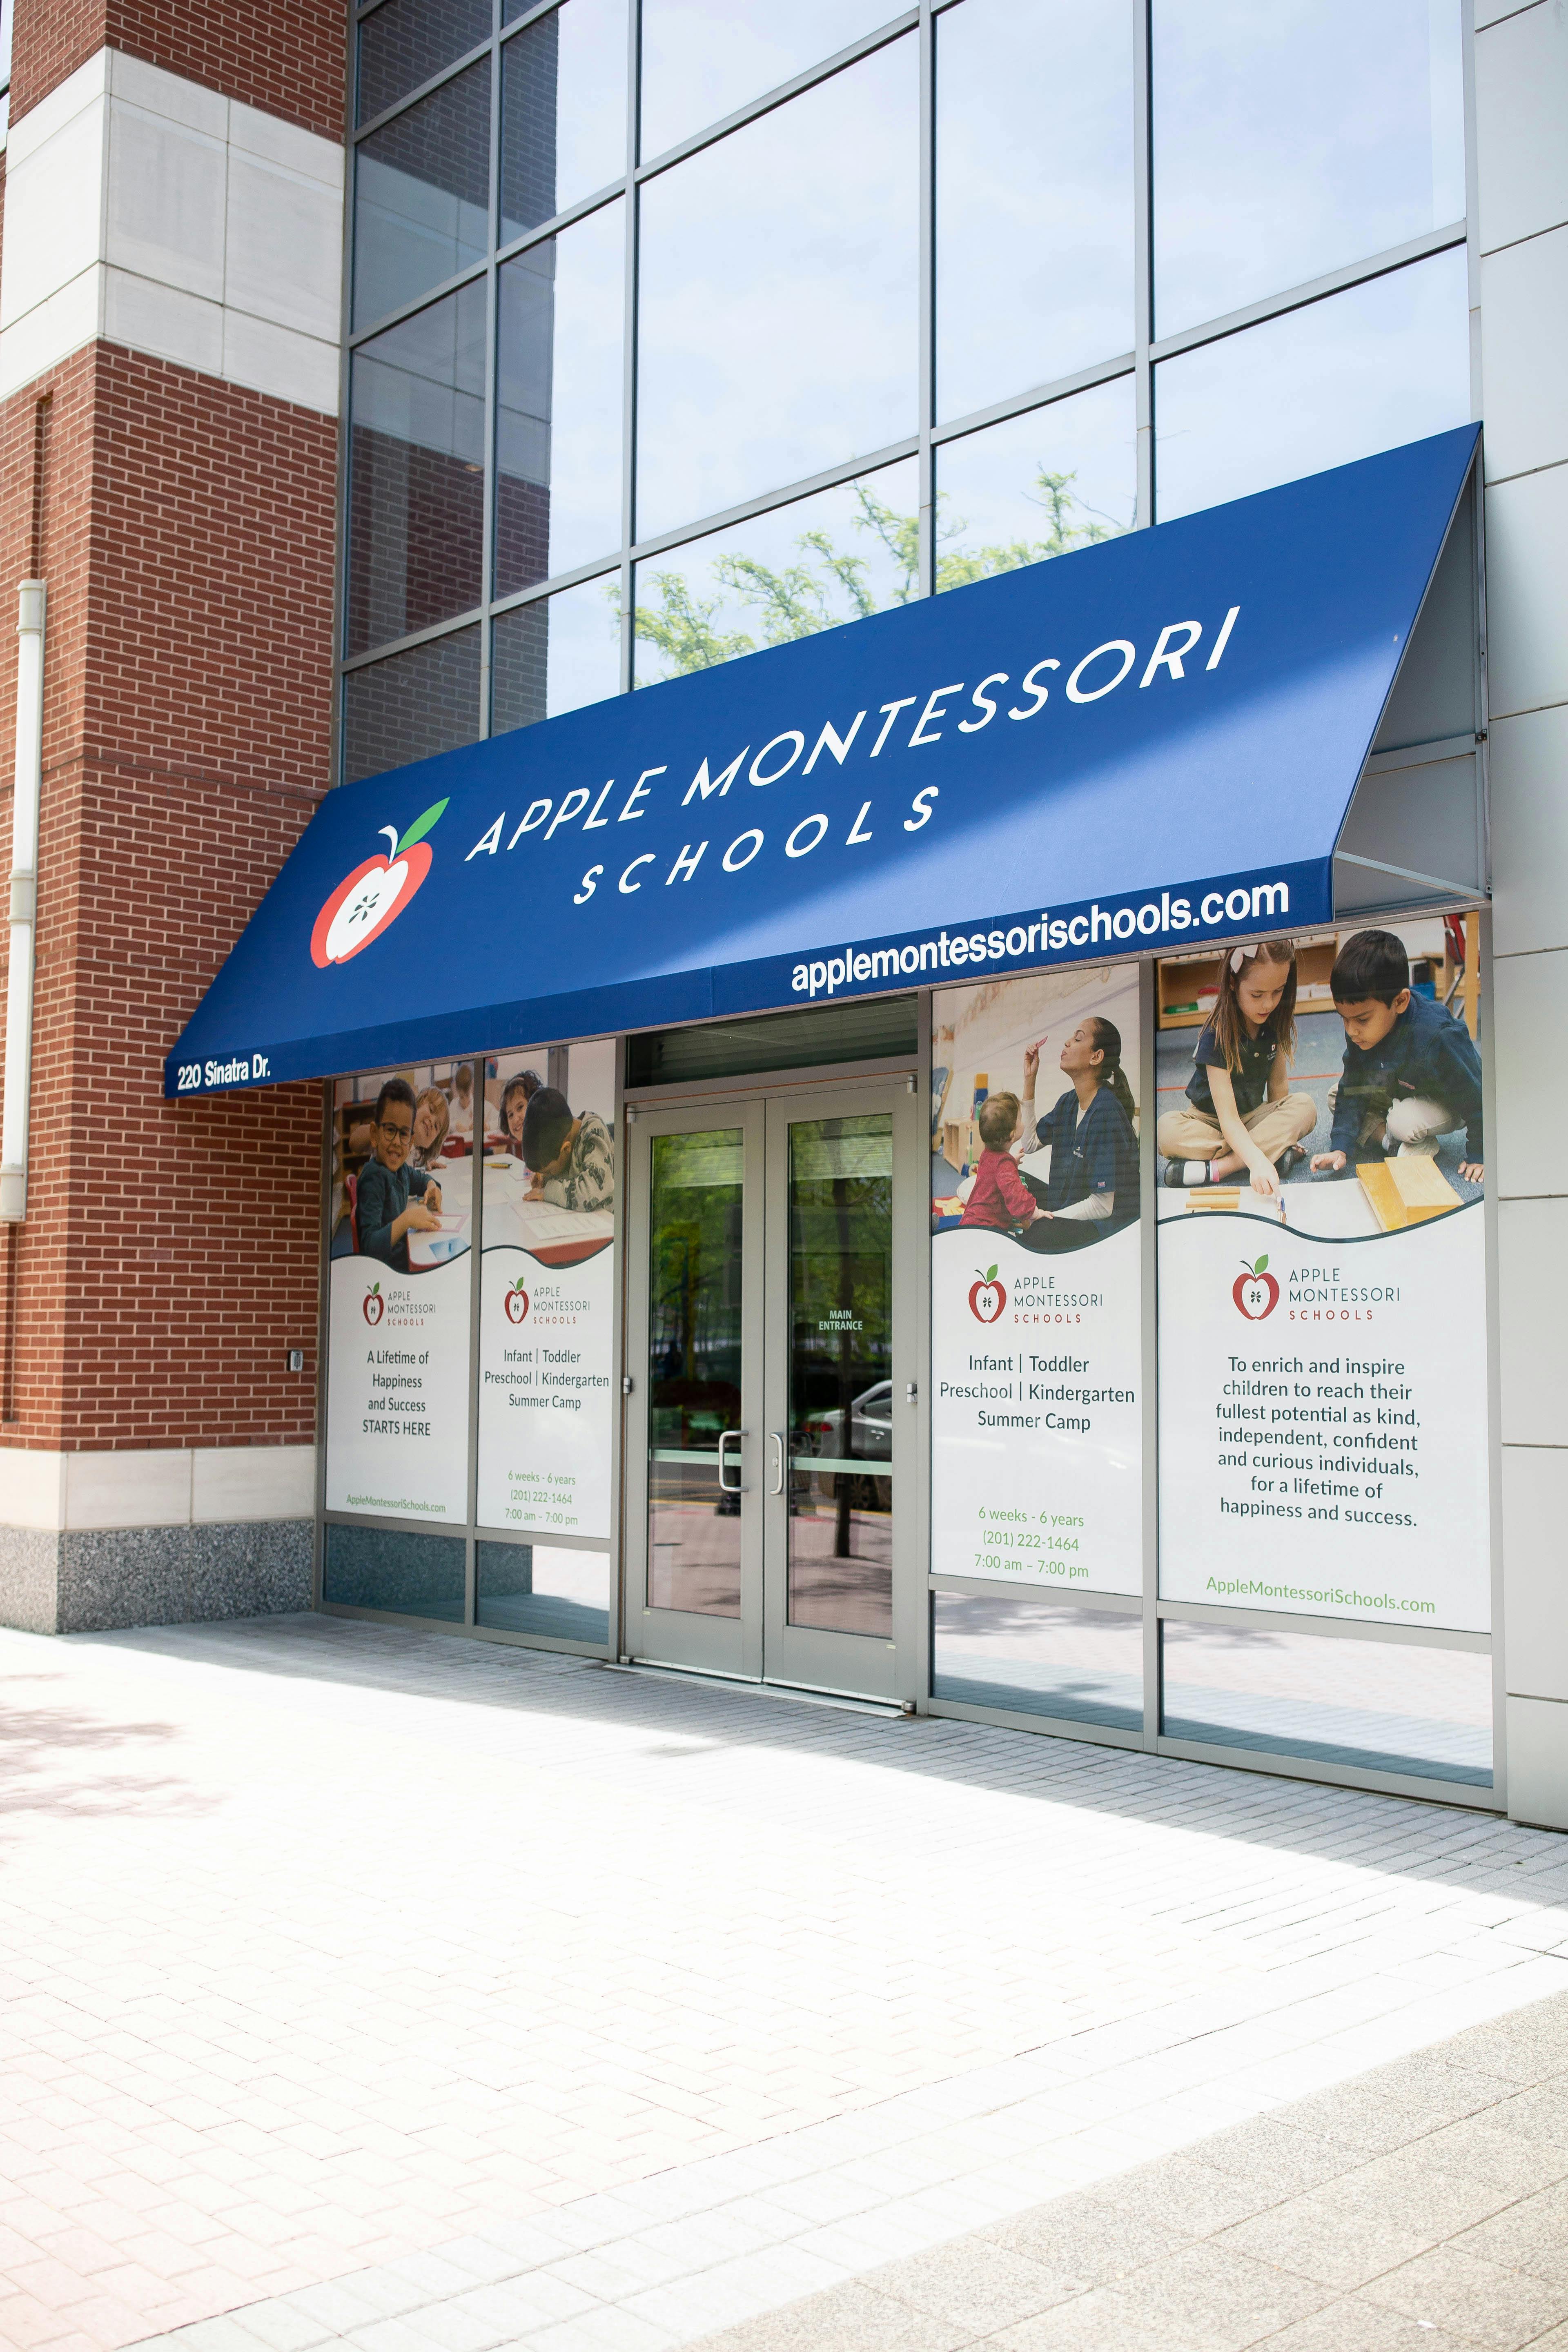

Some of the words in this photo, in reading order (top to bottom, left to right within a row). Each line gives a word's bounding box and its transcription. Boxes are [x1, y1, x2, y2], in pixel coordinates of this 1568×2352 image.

[465, 765, 667, 861] APPLE
[681, 606, 1241, 806] MONTESSORI
[573, 786, 939, 905] SCHOOLS
[792, 882, 1289, 997] applemontessorischools.com
[178, 1064, 201, 1090] 220
[205, 1058, 249, 1087] Sinatra
[253, 1054, 270, 1079] Dr.
[1014, 1276, 1055, 1289] APPLE
[1289, 1268, 1340, 1282] APPLE
[388, 1291, 410, 1301] APPLE
[534, 1287, 560, 1297] APPLE
[1014, 1294, 1102, 1307] MONTESSORI
[1290, 1287, 1399, 1302] MONTESSORI
[388, 1304, 436, 1314] MONTESSORI
[534, 1301, 590, 1311] MONTESSORI
[829, 1310, 852, 1319] MAIN
[388, 1318, 424, 1326] SCHOOLS
[533, 1316, 576, 1324] SCHOOLS
[1014, 1314, 1080, 1323] SCHOOLS
[1290, 1310, 1372, 1320] SCHOOLS
[819, 1321, 863, 1330] ENTRANCE
[367, 1350, 374, 1363] A
[377, 1350, 416, 1364] Lifetime
[419, 1351, 429, 1364] of
[504, 1349, 532, 1362] Infant
[542, 1350, 581, 1363] Toddler
[970, 1355, 1013, 1371] Infant
[1029, 1355, 1089, 1372] Toddler
[1228, 1357, 1247, 1372] To
[1252, 1357, 1303, 1372] enrich
[1309, 1358, 1339, 1373] and
[1346, 1358, 1405, 1377] inspire
[373, 1373, 422, 1390] Happiness
[485, 1371, 531, 1384] Preschool
[542, 1372, 609, 1389] Kindergarten
[940, 1382, 1012, 1399] Preschool
[1029, 1384, 1134, 1405] Kindergarten
[1223, 1380, 1288, 1396] children
[1294, 1383, 1311, 1397] to
[1317, 1383, 1363, 1399] reach
[1370, 1383, 1412, 1400] their
[368, 1396, 385, 1410] and
[388, 1397, 425, 1412] Success
[509, 1394, 549, 1407] Summer
[552, 1395, 581, 1412] Camp
[978, 1410, 1041, 1428] Summer
[1045, 1413, 1091, 1433] Camp
[1216, 1403, 1266, 1420] fullest
[1272, 1406, 1346, 1423] potential
[1353, 1412, 1371, 1423] as
[1377, 1408, 1420, 1428] kind,
[363, 1419, 400, 1434] STARTS
[403, 1421, 431, 1436] HERE
[1219, 1426, 1327, 1449] independent,
[1333, 1432, 1418, 1450] confident
[1218, 1451, 1247, 1466] and
[1253, 1453, 1313, 1470] curious
[1319, 1455, 1419, 1479] individuals,
[508, 1470, 513, 1480] 6
[515, 1471, 539, 1482] weeks
[547, 1473, 552, 1483] 6
[554, 1476, 575, 1486] years
[1251, 1476, 1274, 1492] for
[1279, 1481, 1287, 1493] a
[1294, 1478, 1359, 1497] lifetime
[1365, 1483, 1383, 1499] of
[346, 1494, 445, 1513] AppleMontessoriSchools.com
[510, 1489, 531, 1503] (201)
[533, 1491, 572, 1504] 222-1464
[505, 1508, 522, 1520] 7:00
[523, 1512, 536, 1521] am
[545, 1512, 563, 1523] 7:00
[565, 1517, 578, 1526] pm
[979, 1506, 986, 1519] 6
[989, 1508, 1027, 1522] weeks
[1040, 1511, 1047, 1523] 6
[1051, 1515, 1084, 1527] years
[1221, 1497, 1302, 1518] happiness
[1308, 1505, 1338, 1521] and
[1345, 1510, 1417, 1526] success.
[983, 1530, 1013, 1548] (201)
[1018, 1533, 1079, 1551] 222-1464
[974, 1554, 1001, 1568] 7:00
[1004, 1560, 1022, 1571] am
[1038, 1560, 1065, 1575] 7:00
[1069, 1566, 1089, 1579] pm
[1206, 1577, 1435, 1614] AppleMontessoriSchools.com
